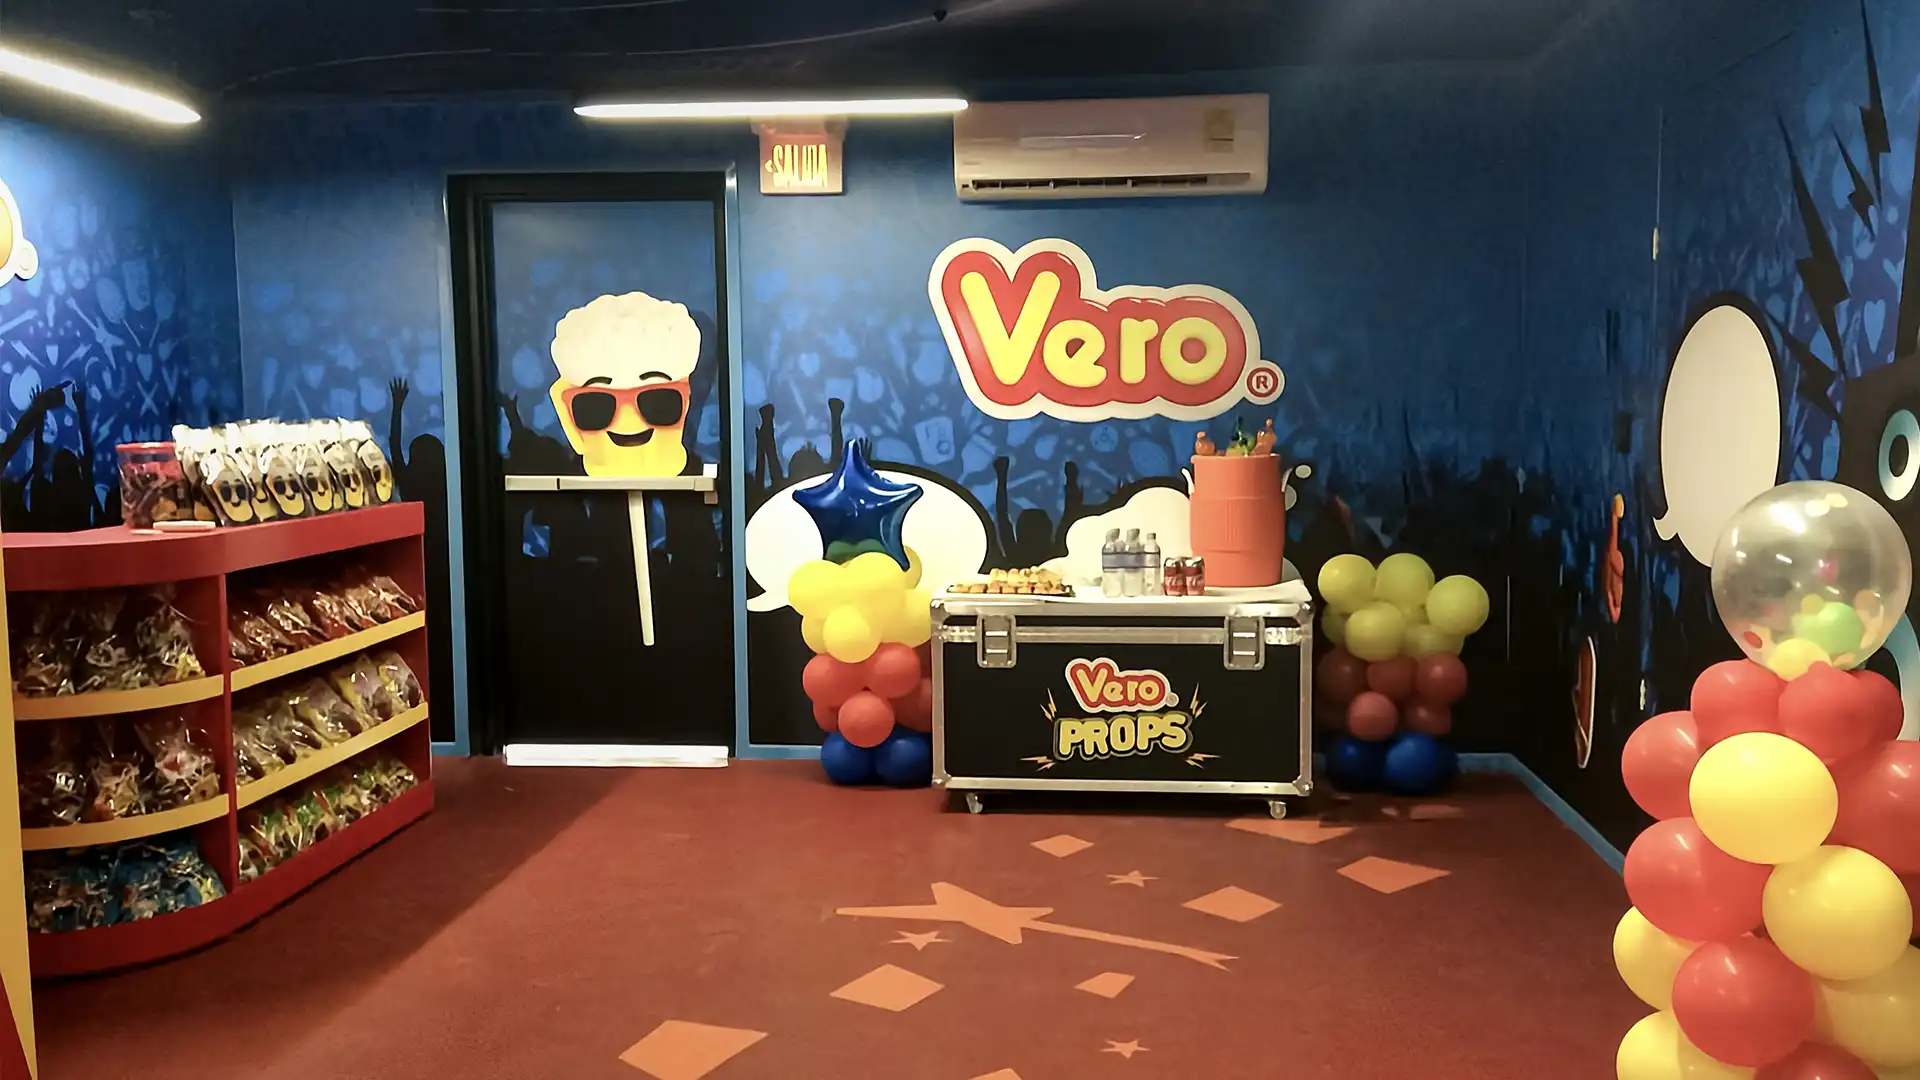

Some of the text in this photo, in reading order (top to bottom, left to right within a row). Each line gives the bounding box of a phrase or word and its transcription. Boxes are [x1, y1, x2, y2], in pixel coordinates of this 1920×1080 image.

[960, 270, 1227, 388] Vero
[1076, 667, 1160, 702] Vero
[1058, 714, 1187, 755] PROPS
